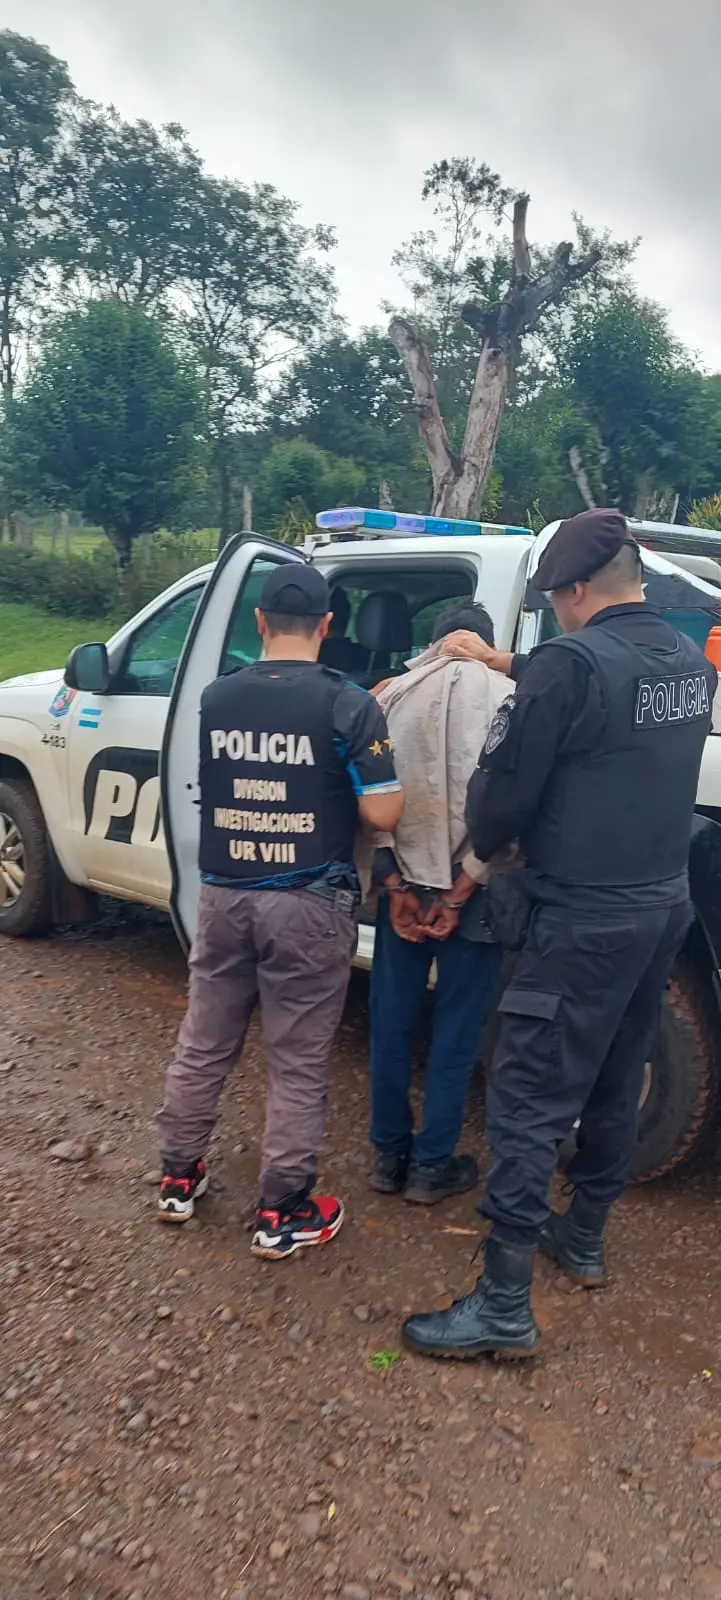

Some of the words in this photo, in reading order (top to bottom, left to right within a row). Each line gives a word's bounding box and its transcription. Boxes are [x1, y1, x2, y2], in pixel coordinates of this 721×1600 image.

[636, 676, 709, 724] POLICIA
[210, 729, 315, 766] POLICIA
[233, 778, 287, 801] DIVISION
[214, 807, 315, 833] INVESTIGACIONES
[229, 839, 257, 862] UR
[259, 842, 296, 864] VIII
